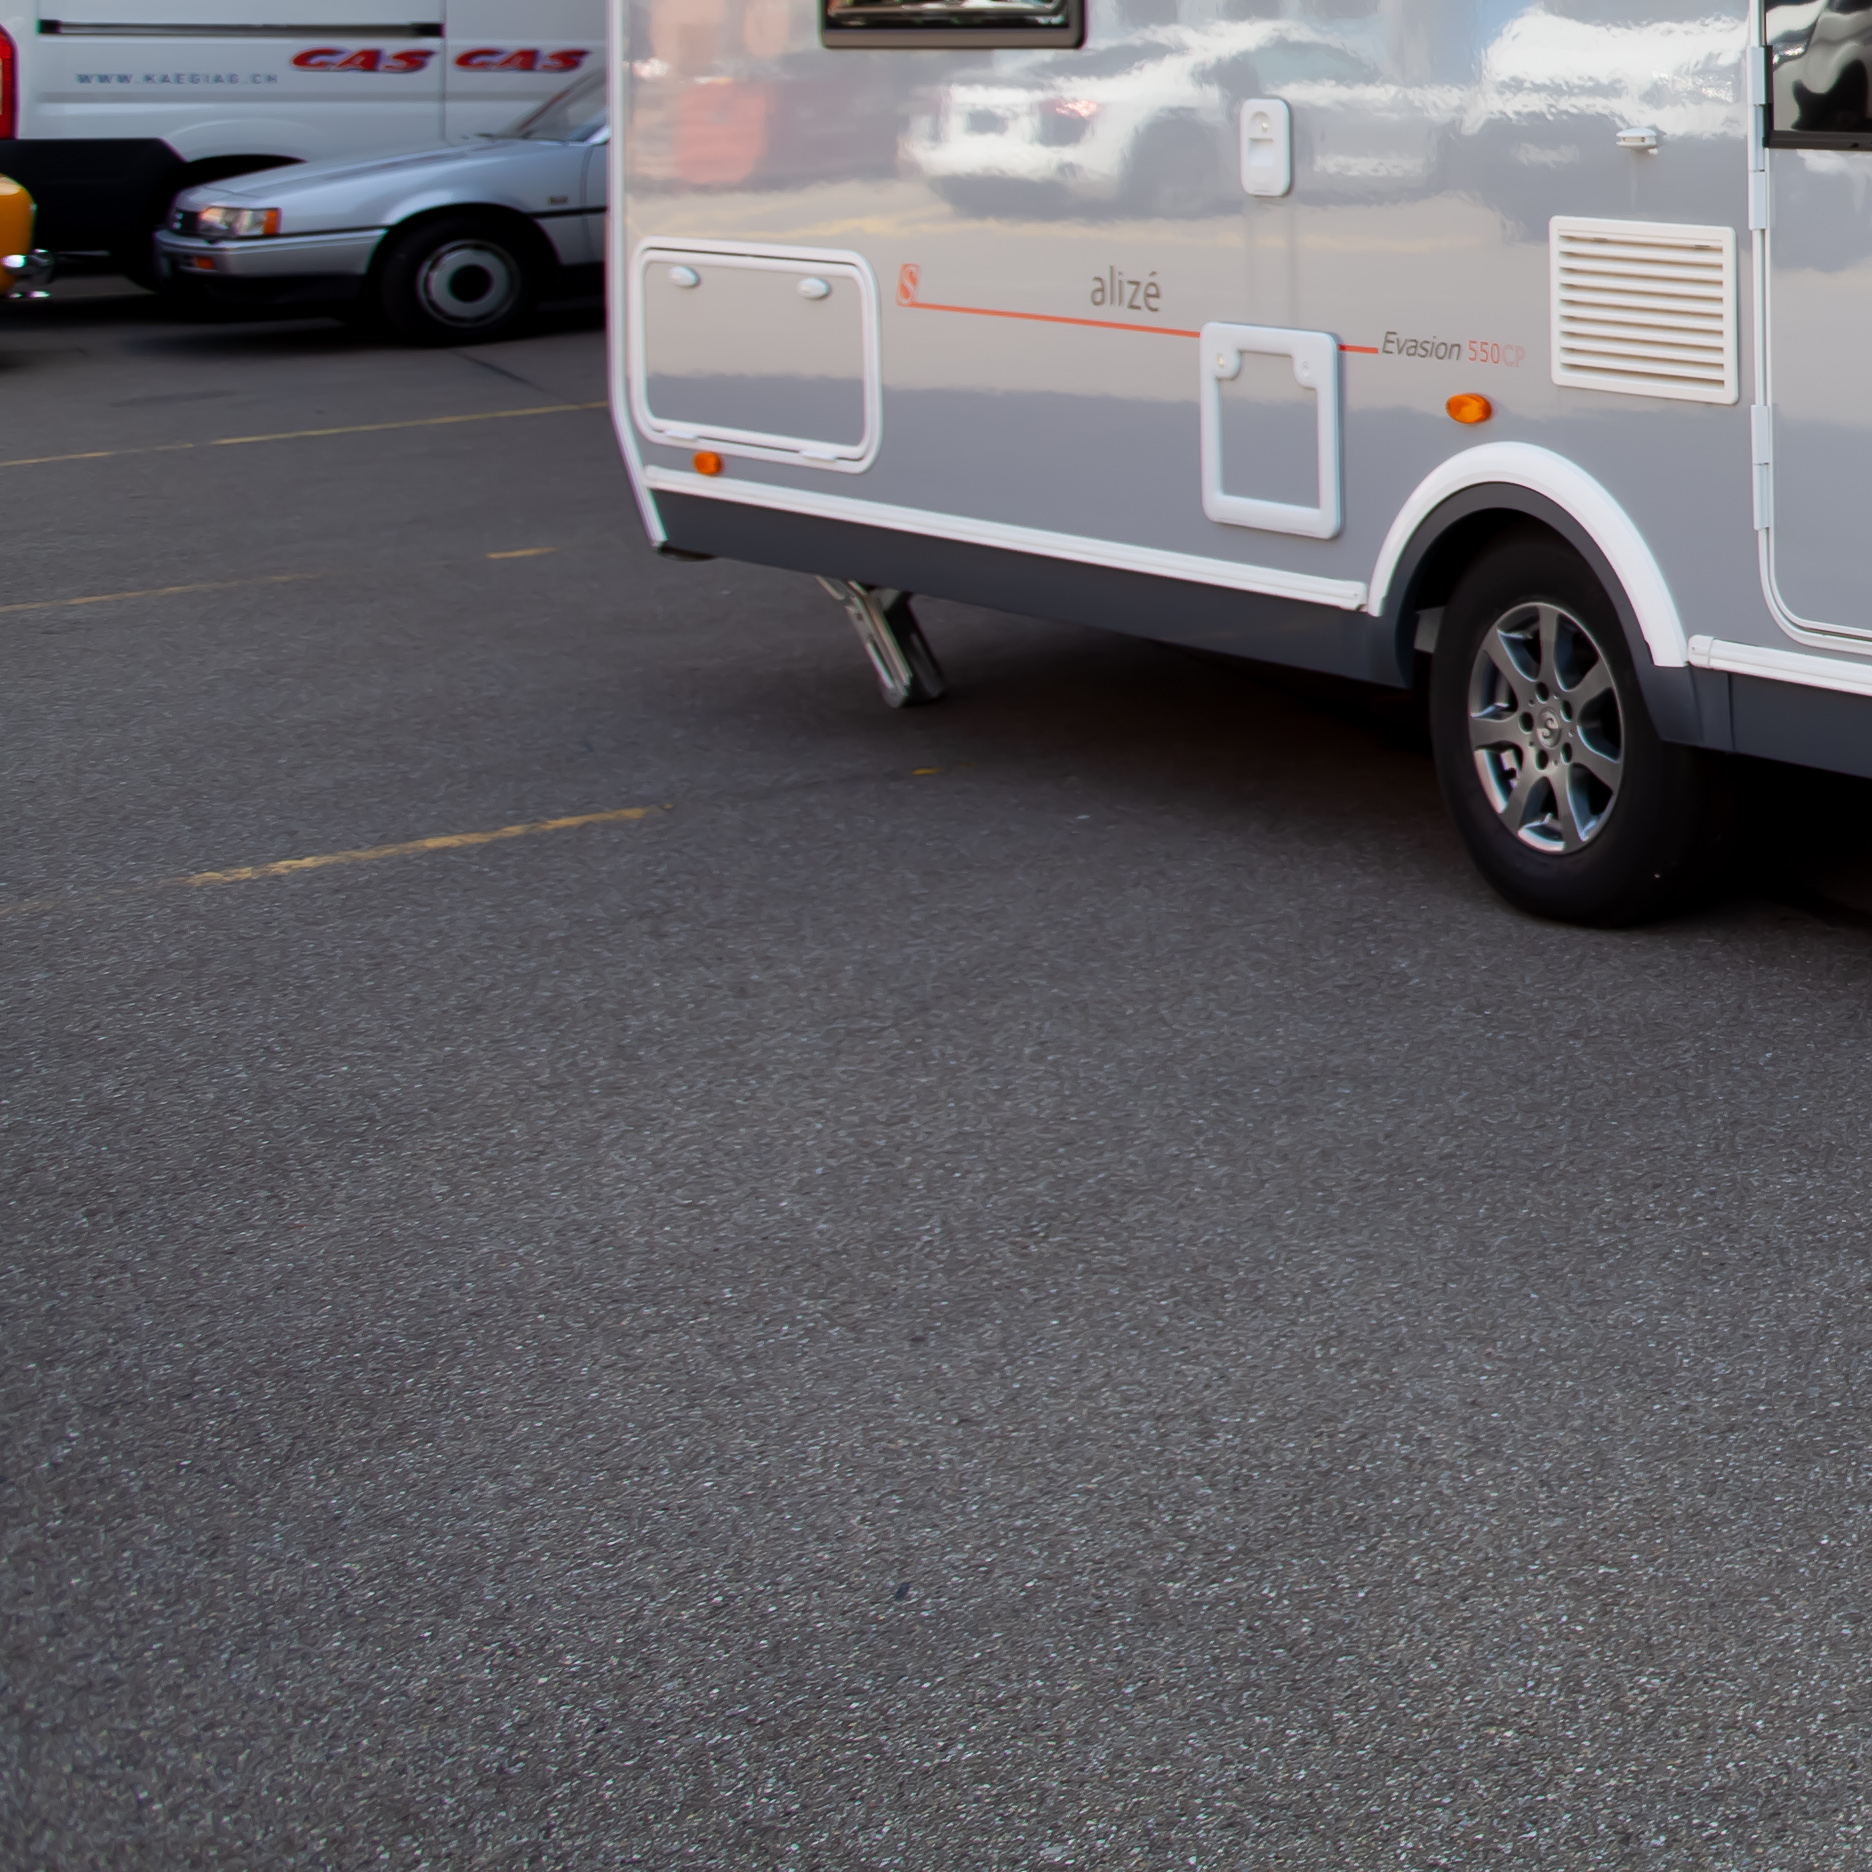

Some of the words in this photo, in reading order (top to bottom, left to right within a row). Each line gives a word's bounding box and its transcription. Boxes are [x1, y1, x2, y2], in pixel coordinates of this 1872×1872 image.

[290, 47, 437, 74] GAS
[453, 47, 590, 74] GAS
[1090, 265, 1162, 313] alizé
[1382, 330, 1461, 360] Evasion
